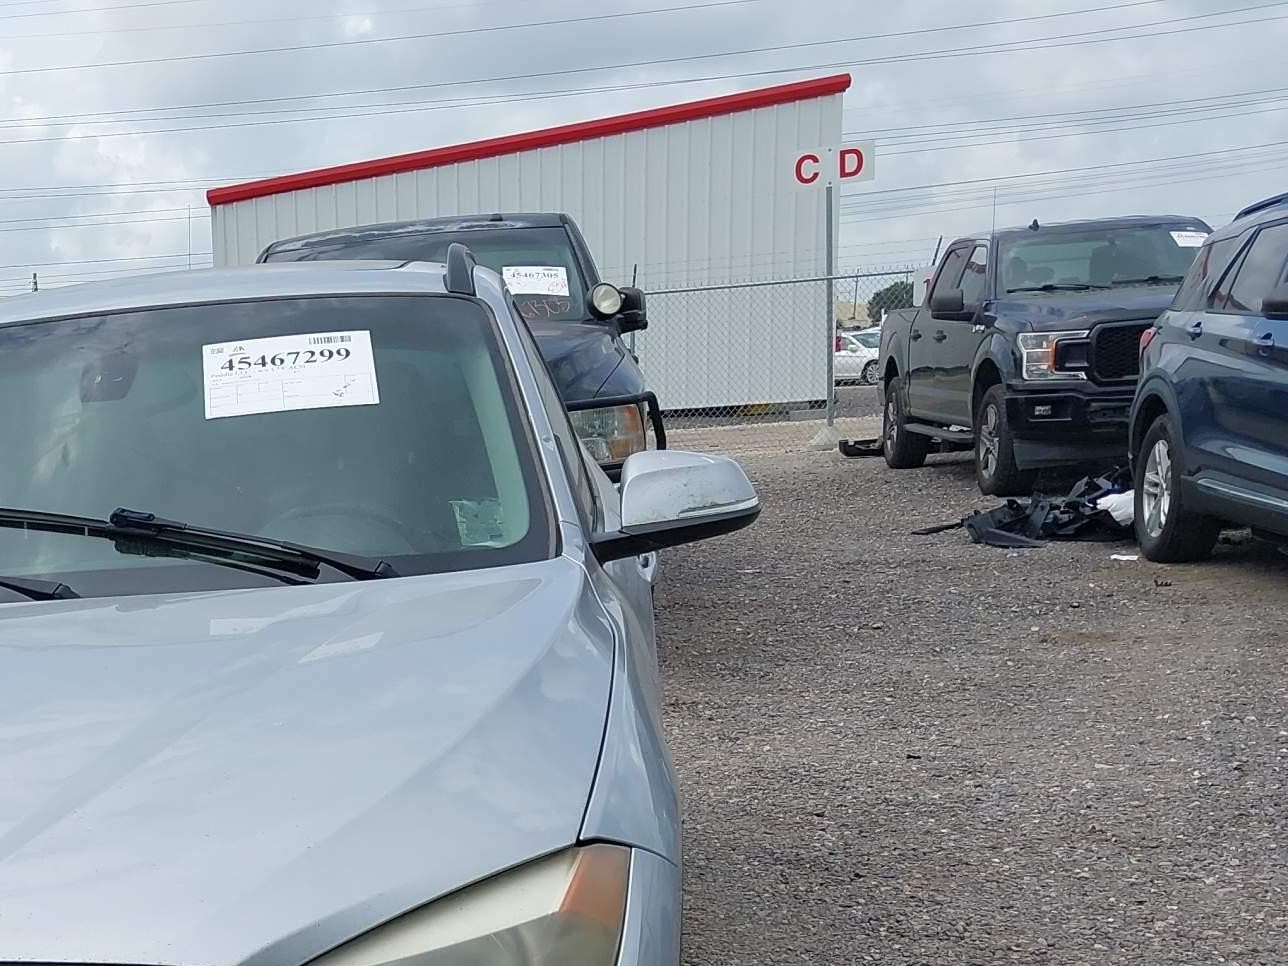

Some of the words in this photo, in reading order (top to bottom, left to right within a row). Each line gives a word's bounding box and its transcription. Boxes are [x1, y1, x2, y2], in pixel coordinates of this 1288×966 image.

[794, 153, 820, 185] C
[838, 147, 865, 179] D
[220, 347, 351, 372] 45467299
